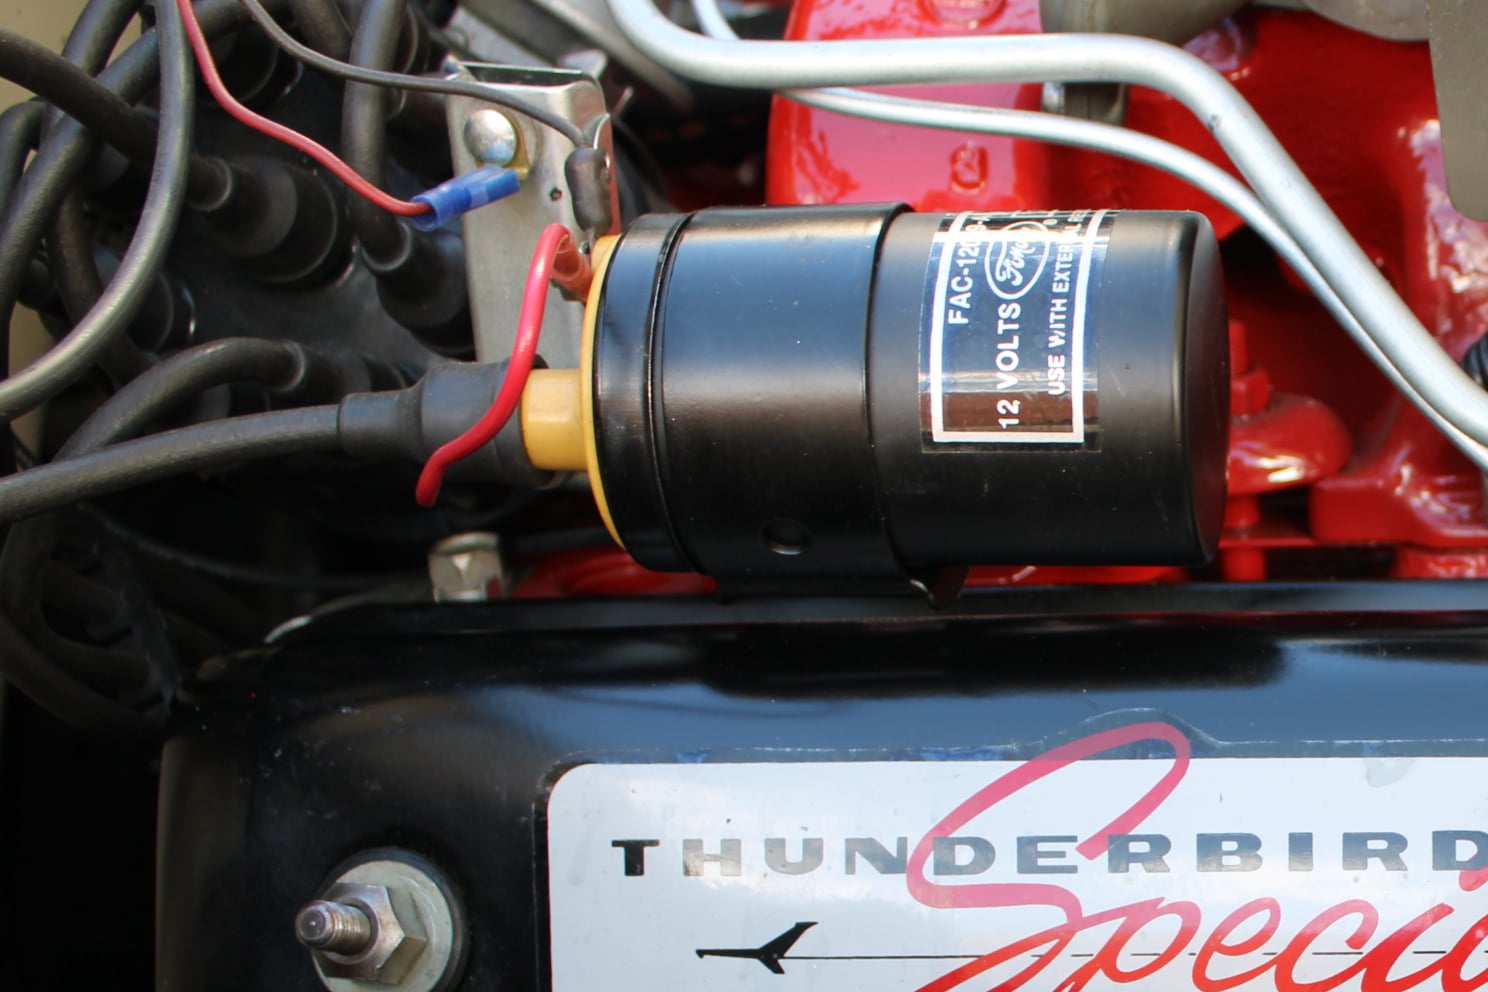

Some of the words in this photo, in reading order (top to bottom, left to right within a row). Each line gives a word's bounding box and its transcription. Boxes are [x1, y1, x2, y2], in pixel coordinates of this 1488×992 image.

[996, 301, 1022, 390] VOLTS
[1048, 299, 1069, 348] WITH
[1047, 355, 1067, 396] USE
[997, 400, 1021, 428] 12
